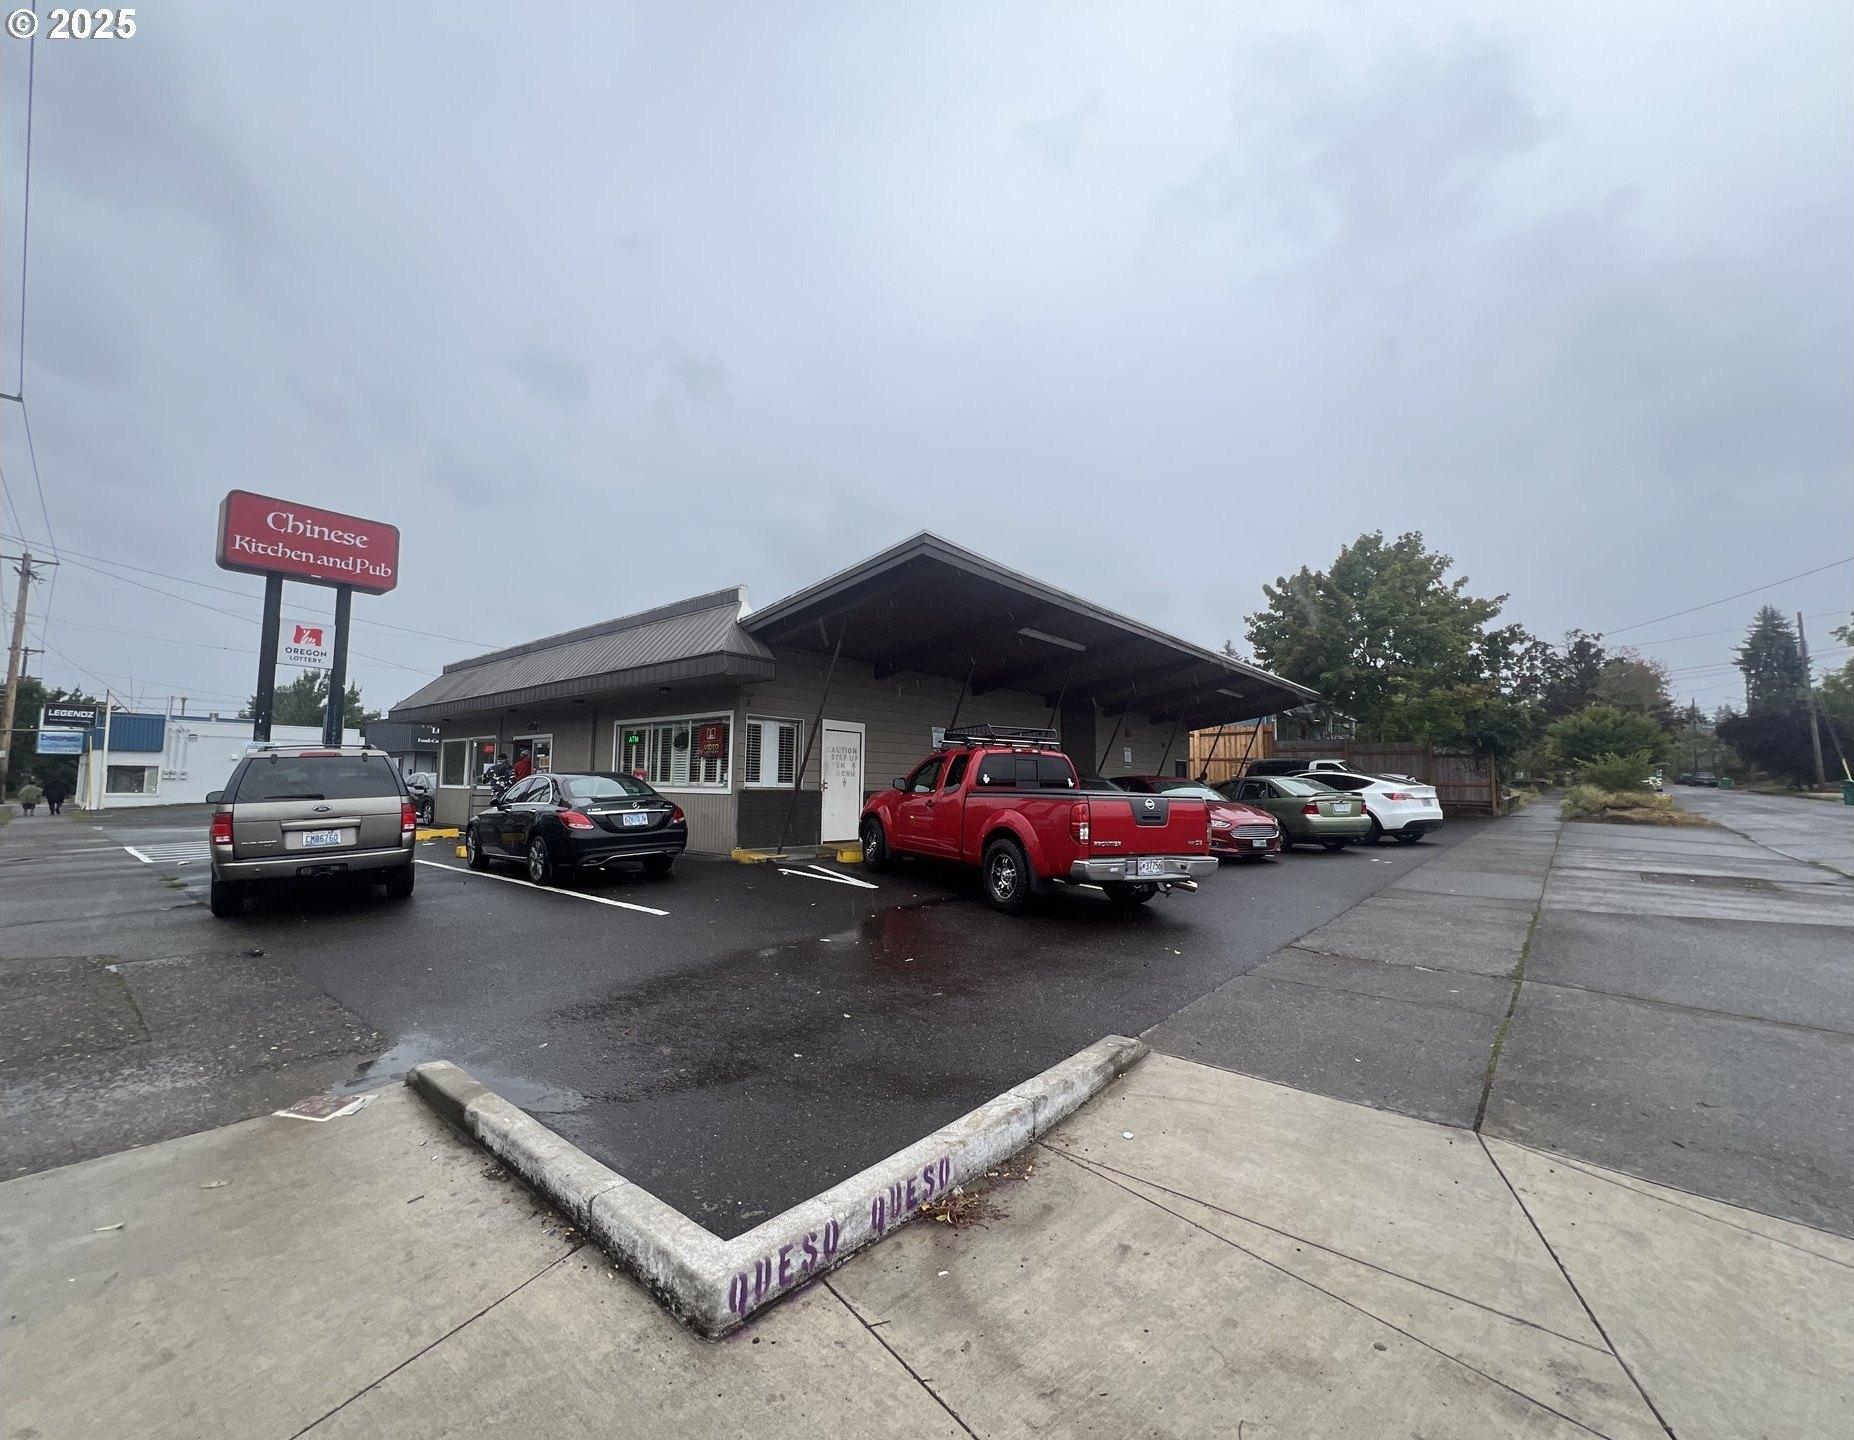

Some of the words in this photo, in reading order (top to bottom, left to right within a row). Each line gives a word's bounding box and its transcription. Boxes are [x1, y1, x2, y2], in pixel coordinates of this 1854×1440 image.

[266, 511, 370, 548] Chinese
[232, 534, 315, 564] Kitchen
[316, 553, 353, 571] and
[353, 558, 392, 577] Pub
[285, 646, 327, 658] OREGON
[289, 655, 323, 663] LOTTERY
[48, 709, 95, 718] LEGENDZ
[628, 735, 639, 743] ATM
[703, 743, 720, 751] VIDEO
[871, 1156, 951, 1233] QUESO
[728, 1219, 841, 1317] QUESO
